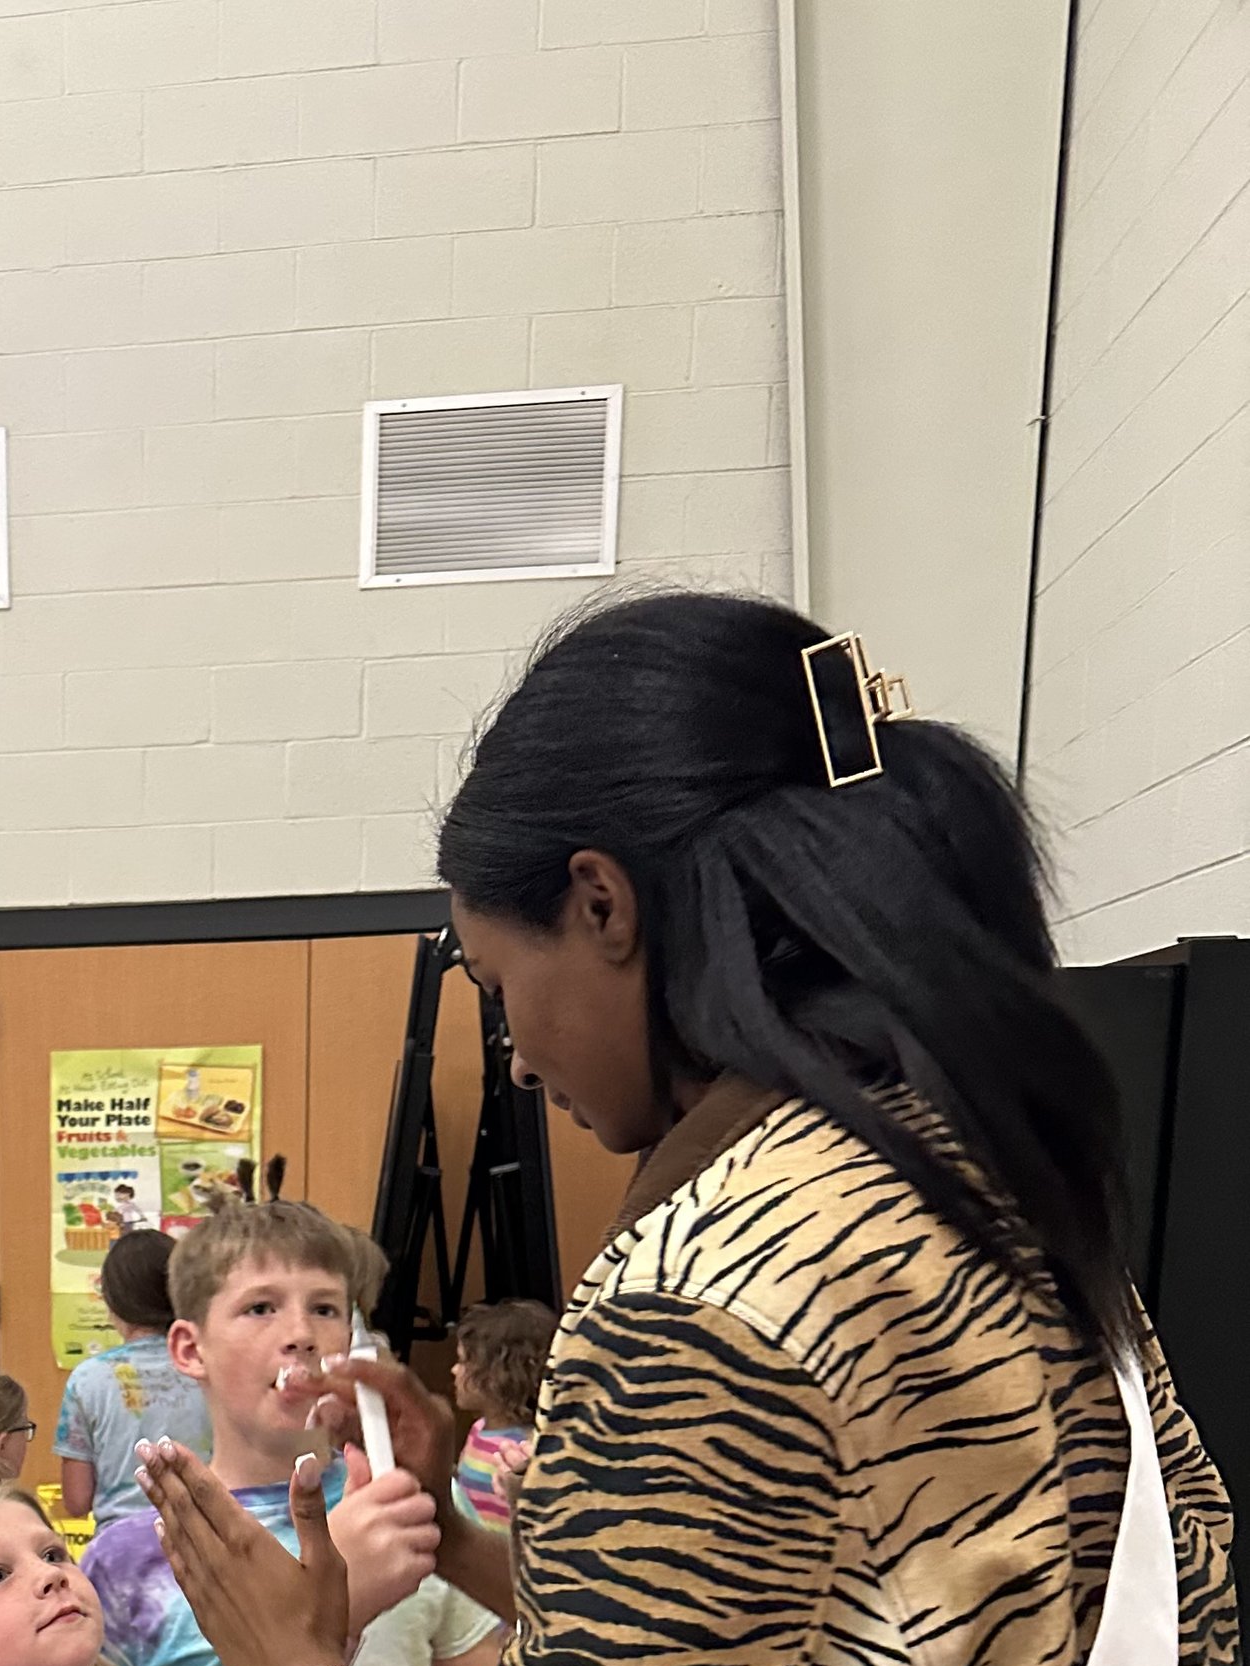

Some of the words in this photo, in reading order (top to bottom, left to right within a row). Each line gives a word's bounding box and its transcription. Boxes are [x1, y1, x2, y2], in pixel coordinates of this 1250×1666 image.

[57, 1099, 105, 1112] Make
[110, 1097, 151, 1111] Half
[56, 1114, 100, 1128] Your
[105, 1113, 151, 1126] Plate
[57, 1130, 112, 1143] Fruits
[116, 1129, 128, 1142] &
[57, 1143, 157, 1160] Vegetables
